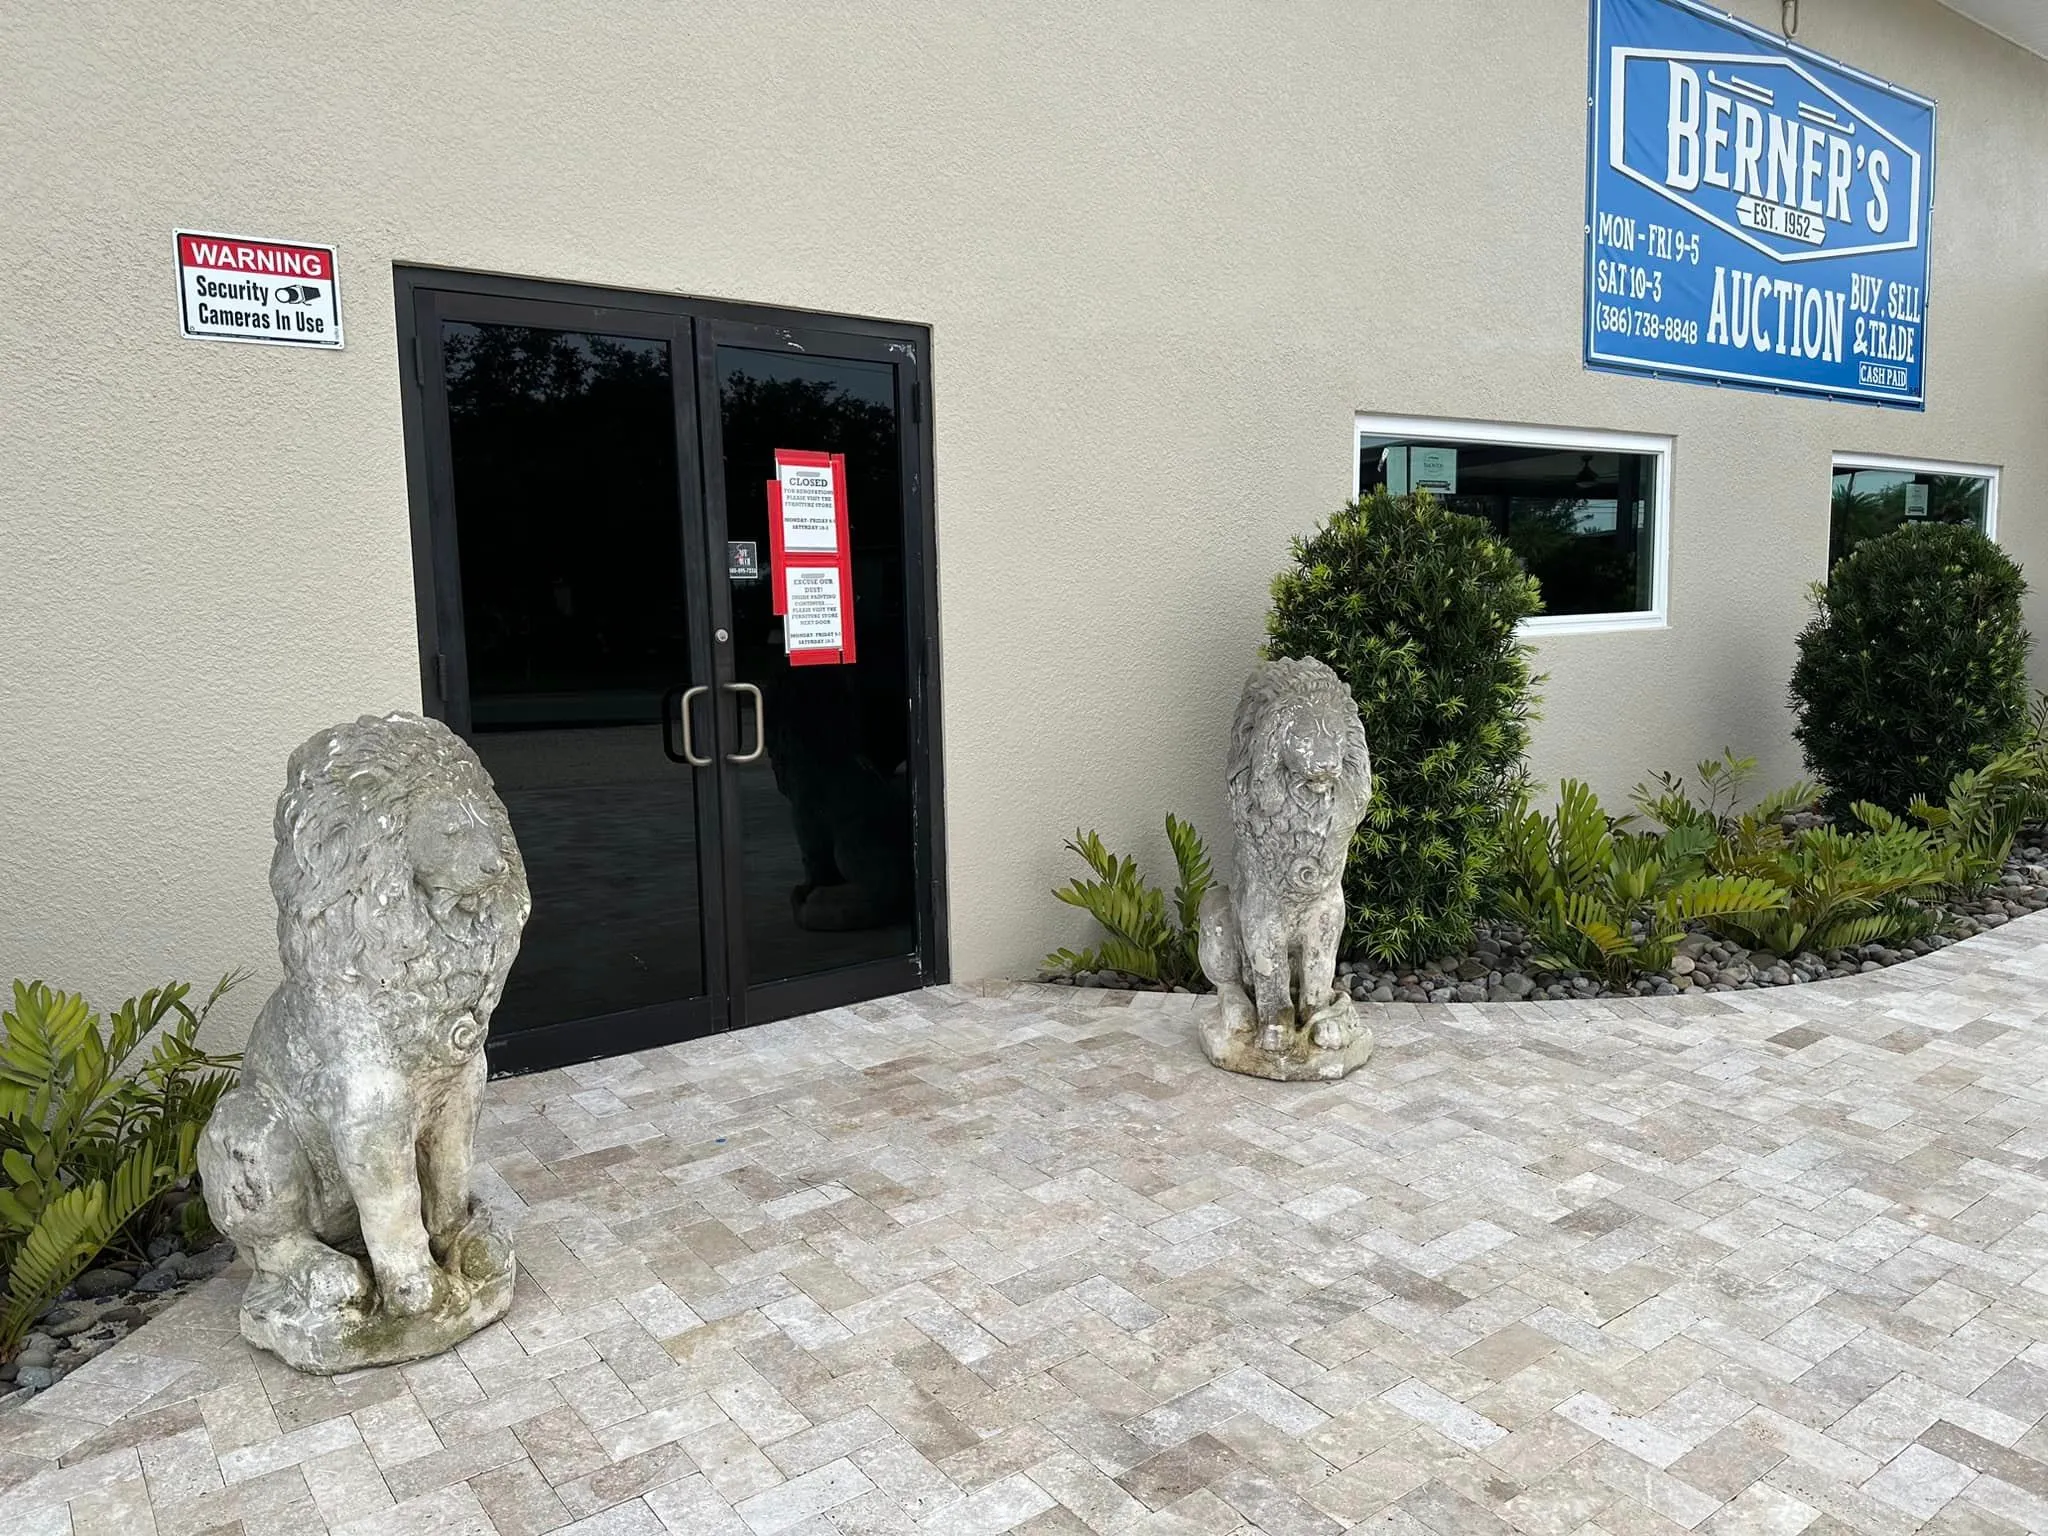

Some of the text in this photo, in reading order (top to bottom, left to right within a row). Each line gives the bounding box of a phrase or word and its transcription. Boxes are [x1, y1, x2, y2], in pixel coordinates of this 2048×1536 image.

[1666, 59, 1890, 233] BERNER'S
[1598, 211, 1635, 252] MON
[1648, 223, 1673, 260] FRI
[1675, 230, 1700, 265] 9-5
[1754, 203, 1811, 238] EST. 1952
[191, 242, 322, 276] WARNING
[196, 275, 269, 306] Security
[1598, 259, 1662, 303] SAT 10-3
[199, 303, 324, 333] Cameras In Use
[1706, 266, 1846, 363] AUCTION
[1888, 281, 1920, 323] SELL
[1596, 300, 1698, 345] (386) 738-8848
[1860, 364, 1906, 387] CASH PAID
[789, 477, 828, 487] CLOSED
